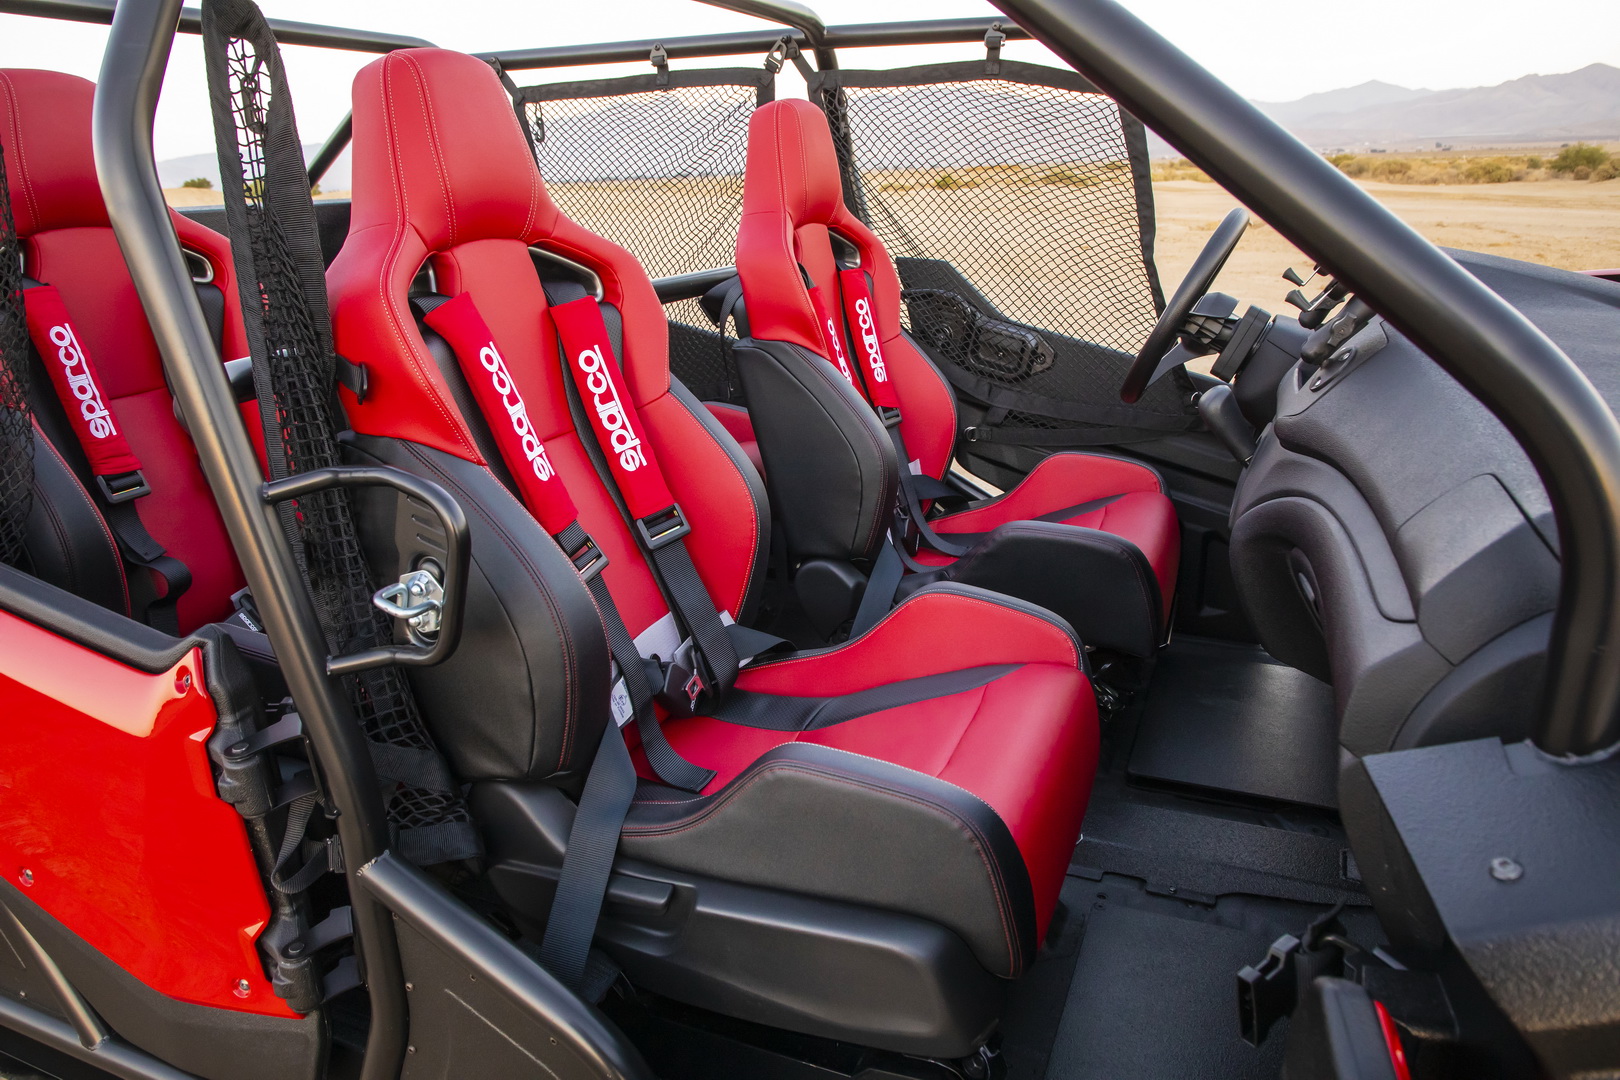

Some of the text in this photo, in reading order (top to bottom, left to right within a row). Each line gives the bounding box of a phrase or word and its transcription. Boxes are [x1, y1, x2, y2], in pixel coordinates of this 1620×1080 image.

[50, 323, 117, 438] sparco
[827, 317, 853, 385] arco
[855, 296, 888, 383] sparco
[480, 341, 556, 482] sparco
[578, 345, 647, 472] sparco
